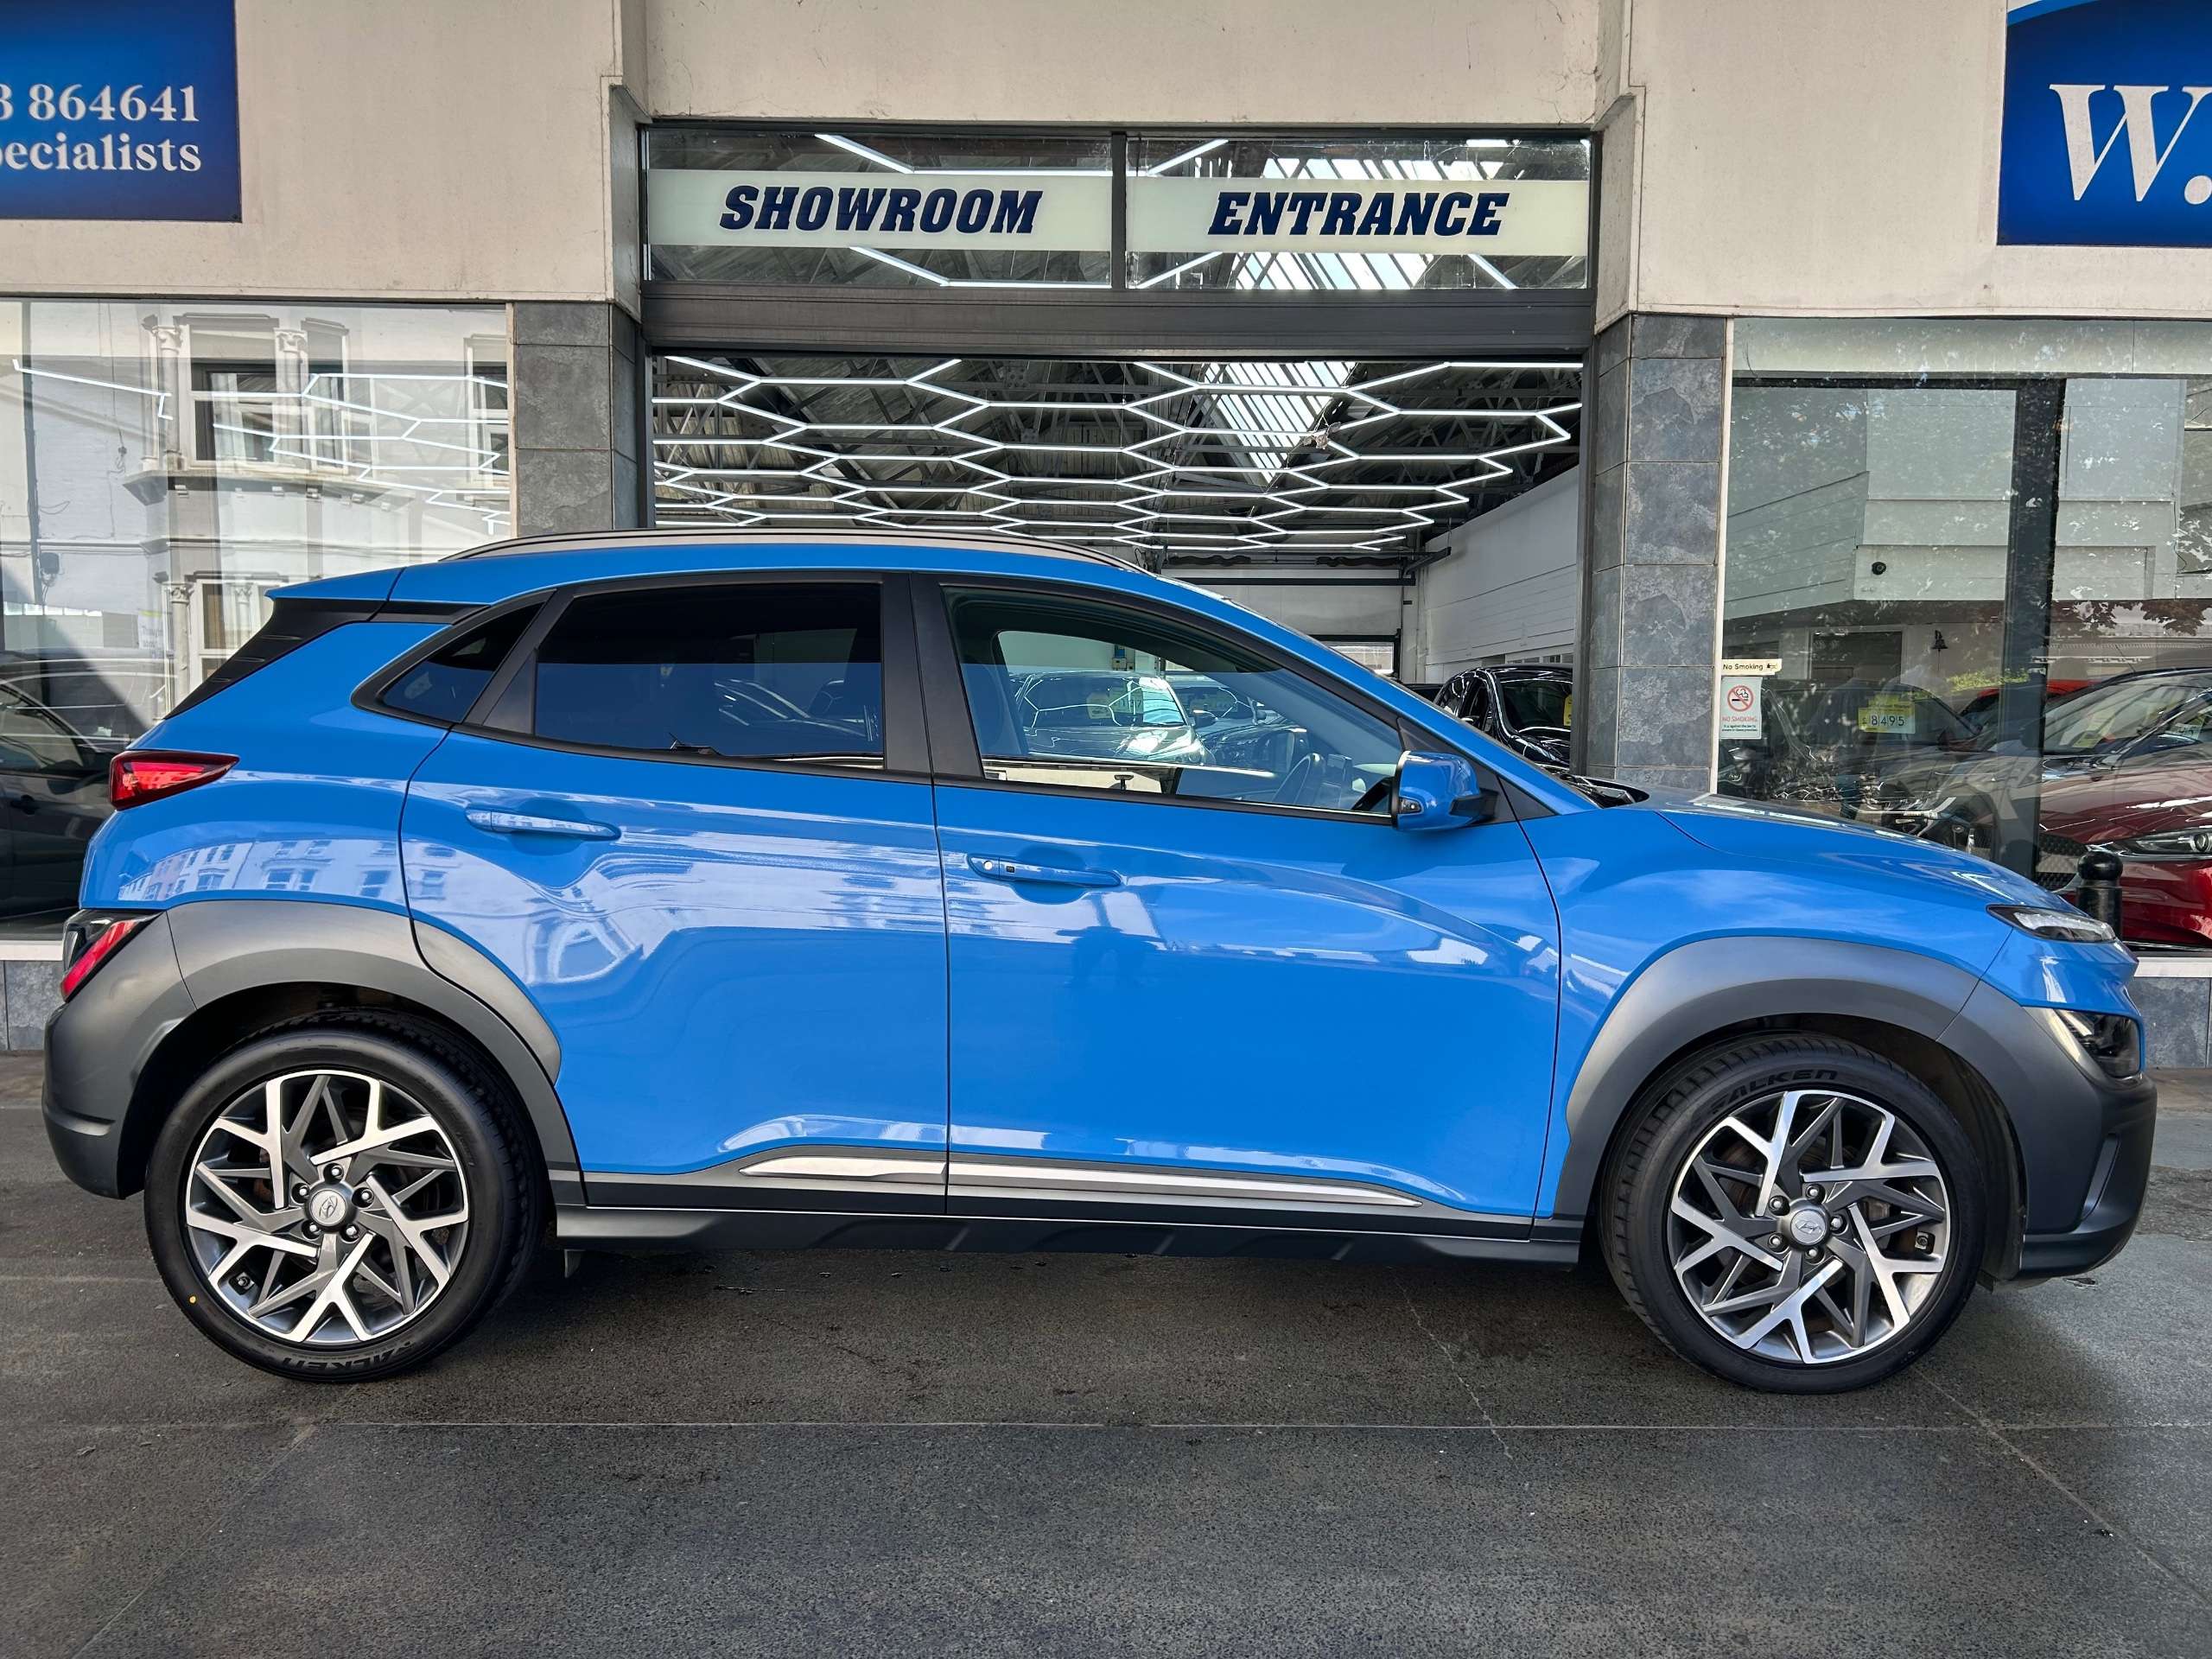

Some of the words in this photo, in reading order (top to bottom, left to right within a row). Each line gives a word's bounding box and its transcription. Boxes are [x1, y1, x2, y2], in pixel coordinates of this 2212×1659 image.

[29, 83, 200, 122] 864641
[0, 131, 201, 171] ecialists
[2049, 84, 2212, 205] W.
[719, 185, 1044, 234] SHOWROOM
[1207, 192, 1510, 236] ENTRANCE
